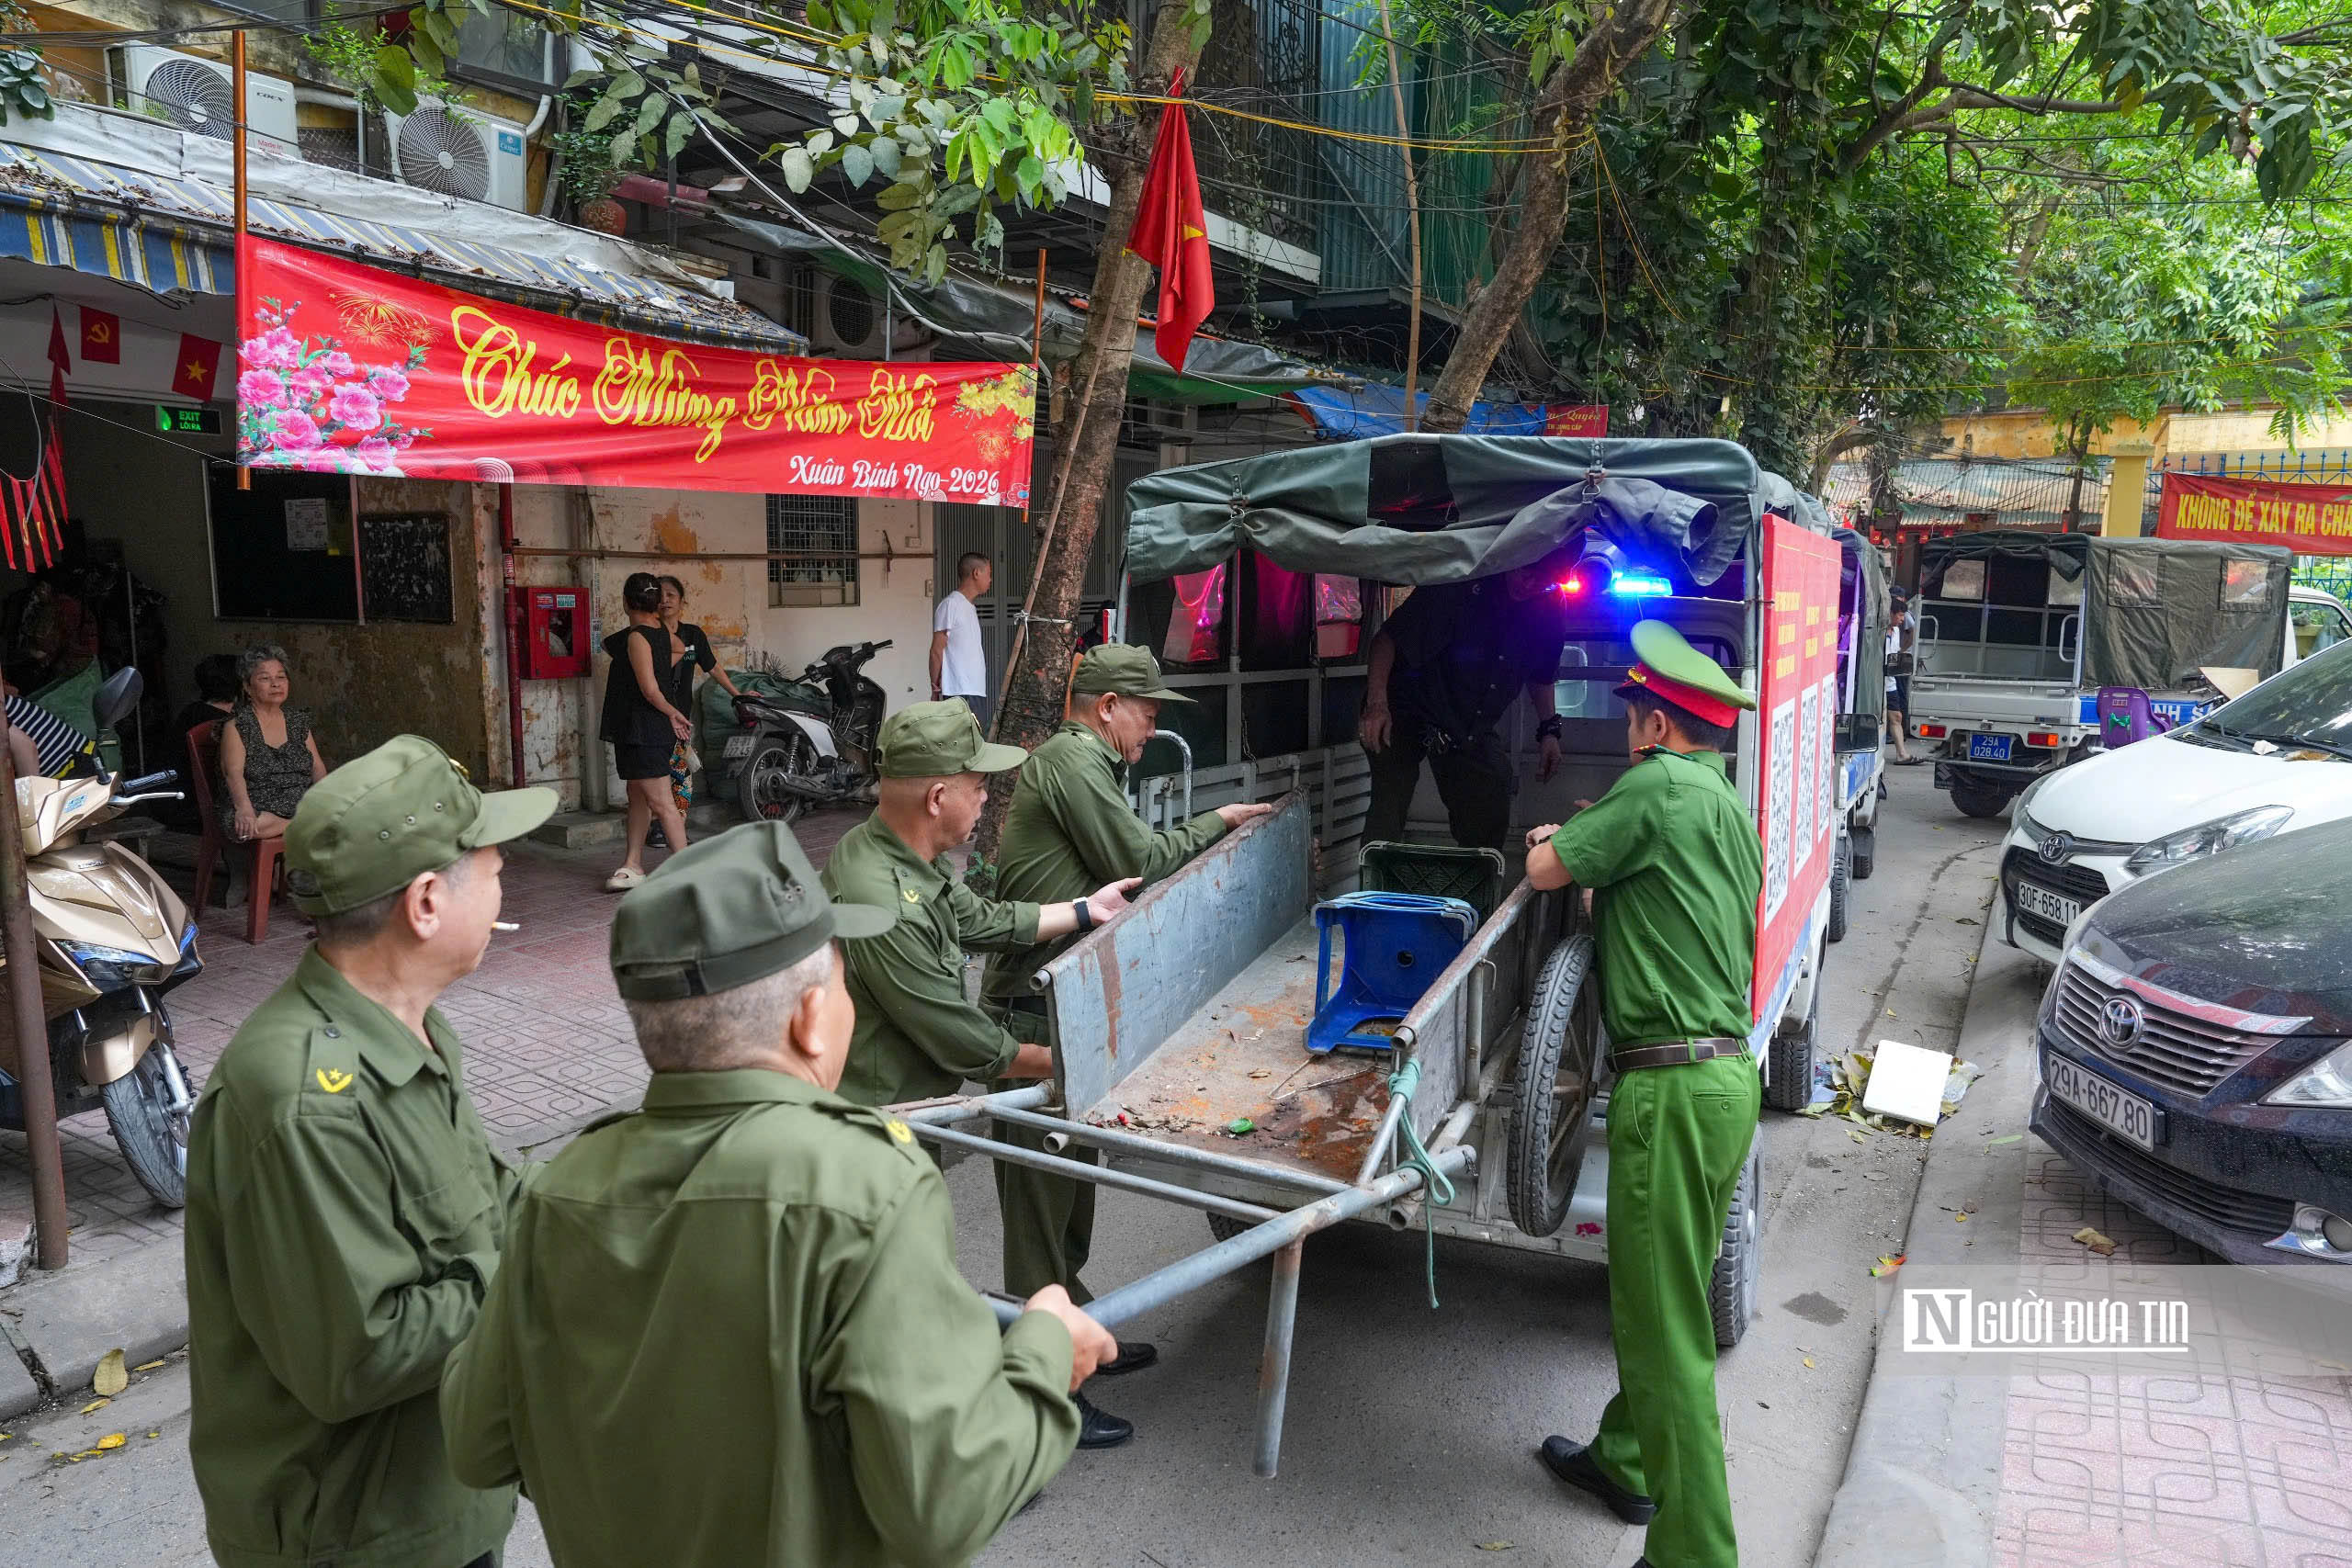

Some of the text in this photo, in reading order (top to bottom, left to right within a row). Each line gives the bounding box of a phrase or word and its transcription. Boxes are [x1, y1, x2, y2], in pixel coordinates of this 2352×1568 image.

[450, 305, 938, 464] Chúc Mừng Năm Mới
[178, 411, 201, 422] EXIT
[787, 455, 846, 486] Xuân
[852, 459, 899, 490] Bính
[2176, 491, 2232, 531] KHÔNG
[2233, 488, 2256, 532] ĐỂ
[2258, 491, 2292, 534] XẢY
[2294, 502, 2316, 535] RA
[1973, 746, 2006, 758] 028.40
[1982, 735, 1999, 746] 29A
[2020, 884, 2076, 924] 30F-658.11
[2051, 1059, 2148, 1141] 29A-667.80
